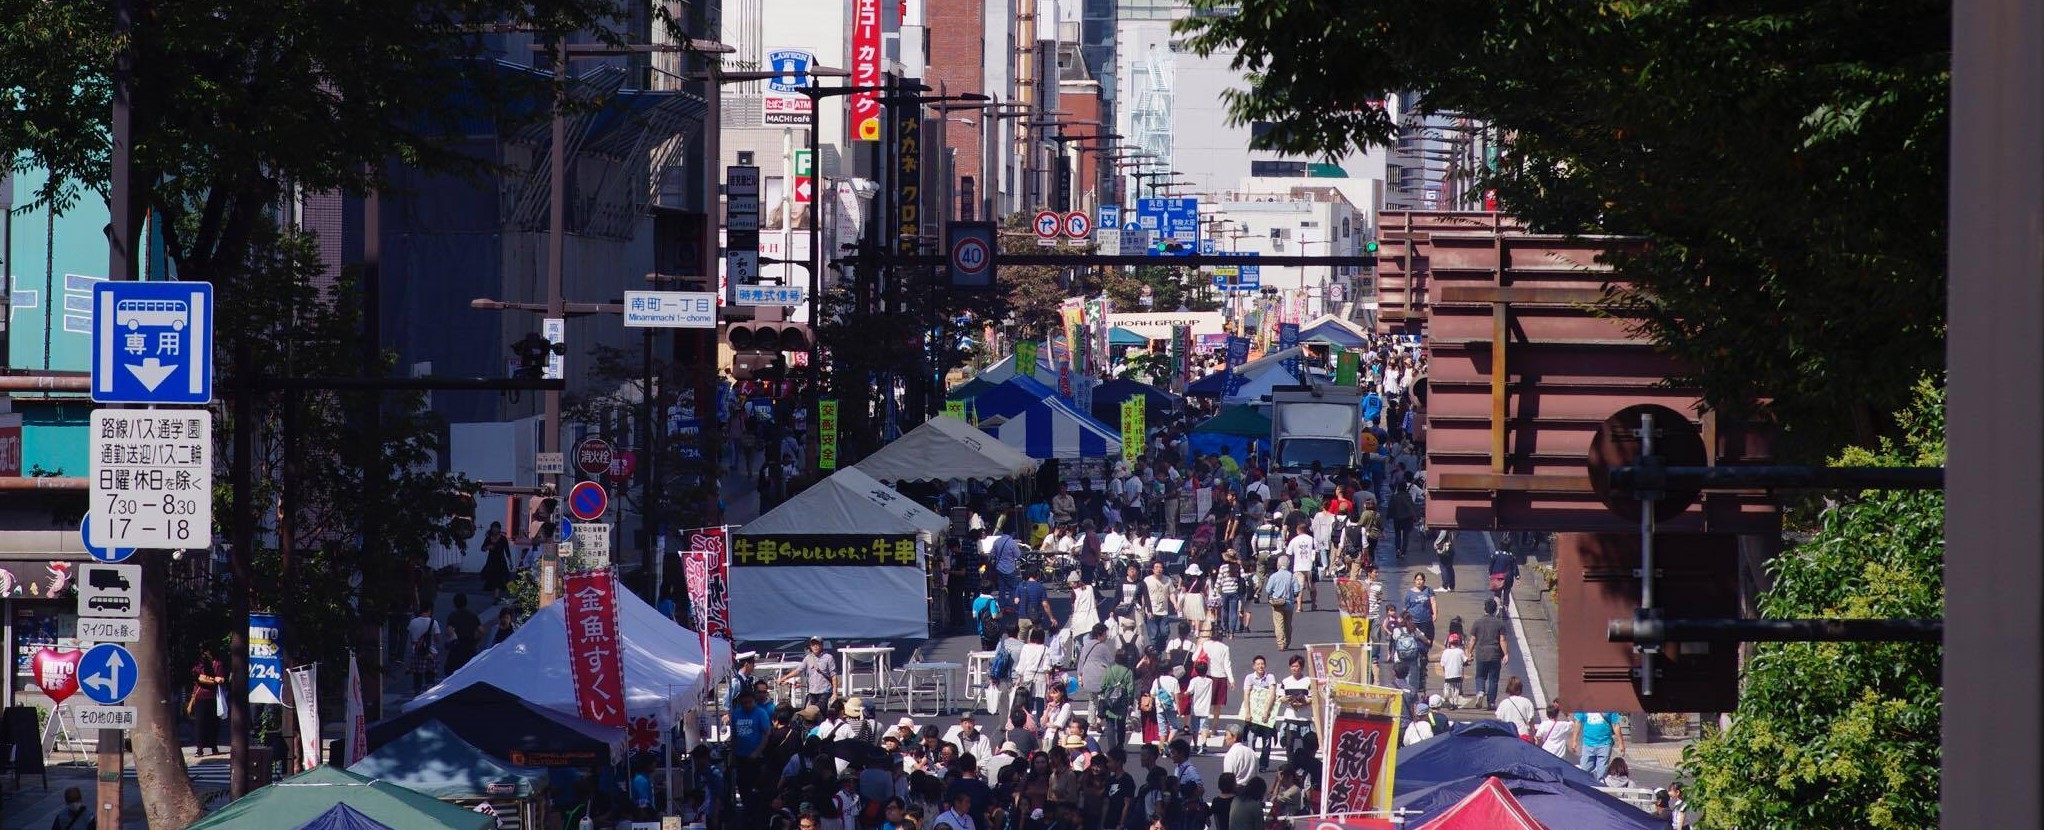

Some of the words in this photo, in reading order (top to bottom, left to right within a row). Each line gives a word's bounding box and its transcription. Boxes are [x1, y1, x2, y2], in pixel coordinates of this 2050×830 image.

[771, 52, 809, 61] LAWSON
[795, 100, 812, 109] ATM
[961, 248, 982, 264] 40
[739, 289, 800, 302] 時差式信号
[631, 297, 709, 312] 南町一丁目
[629, 313, 675, 322] Minamimachi
[124, 332, 180, 356] 専用
[581, 450, 610, 464] 消火栓
[110, 518, 131, 540] 17
[168, 519, 189, 540] 18
[734, 538, 778, 565] 牛串
[872, 538, 916, 565] 牛串
[83, 623, 135, 638] マイクロを除く
[574, 585, 616, 722] 金魚すくい
[81, 710, 133, 724] その他の車両
